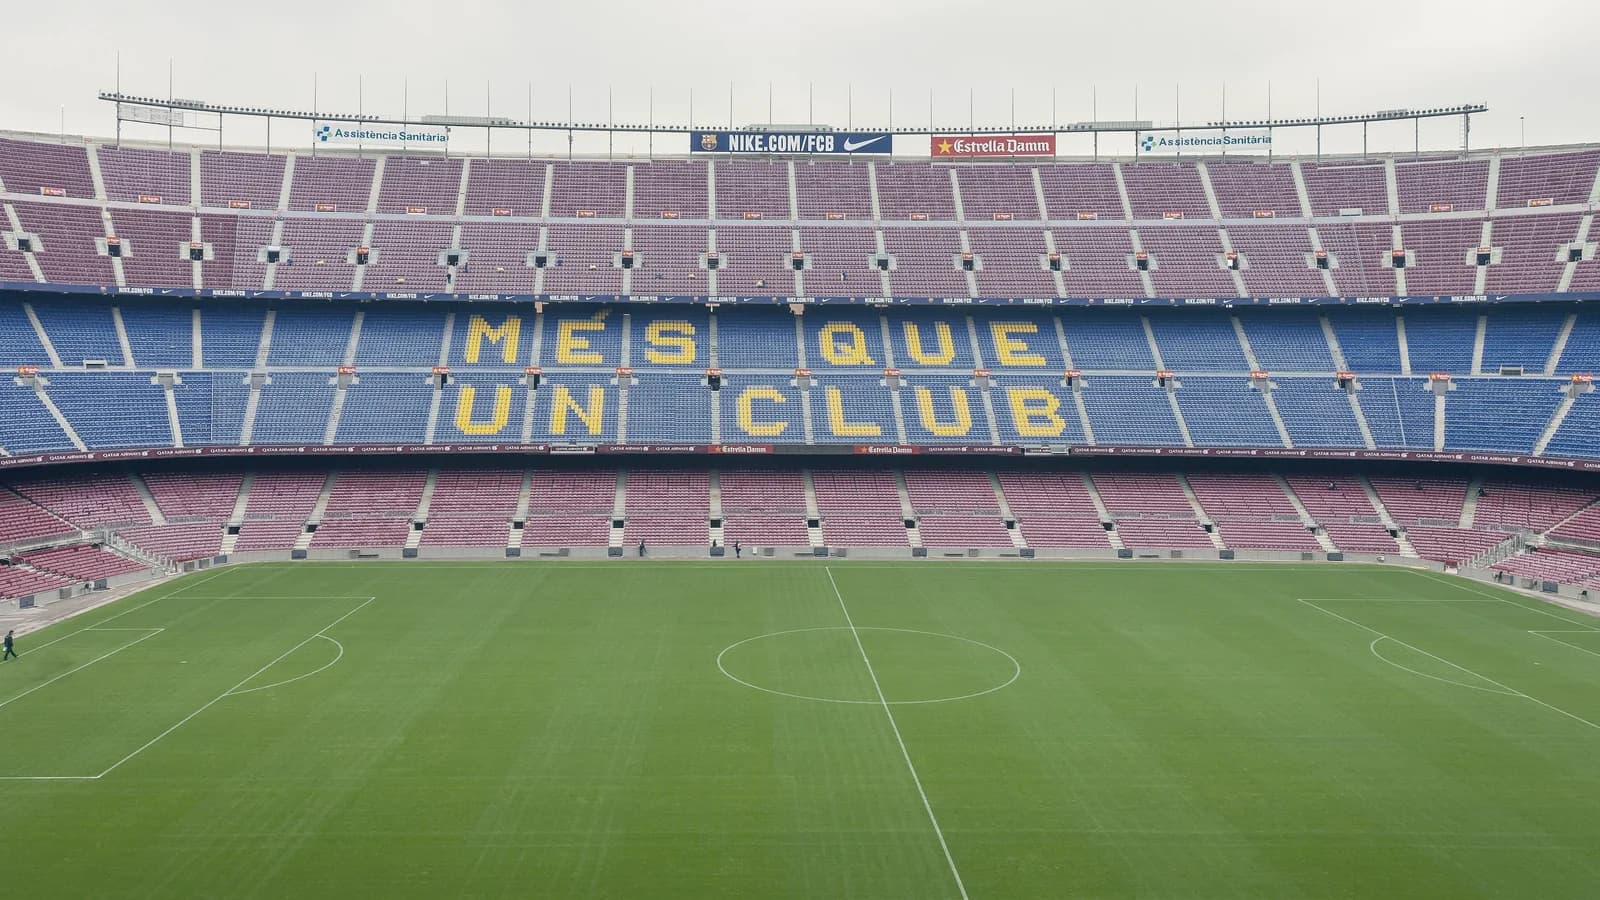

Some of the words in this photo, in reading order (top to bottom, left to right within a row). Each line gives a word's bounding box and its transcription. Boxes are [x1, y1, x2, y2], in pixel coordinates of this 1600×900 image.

[729, 134, 834, 152] NIKE.COM/FCB
[954, 139, 1006, 152] Estrella
[1006, 139, 1050, 152] Damm
[464, 309, 696, 364] MÉS
[818, 321, 1046, 366] QUE
[454, 384, 604, 434] UN
[736, 385, 1066, 436] CLUB
